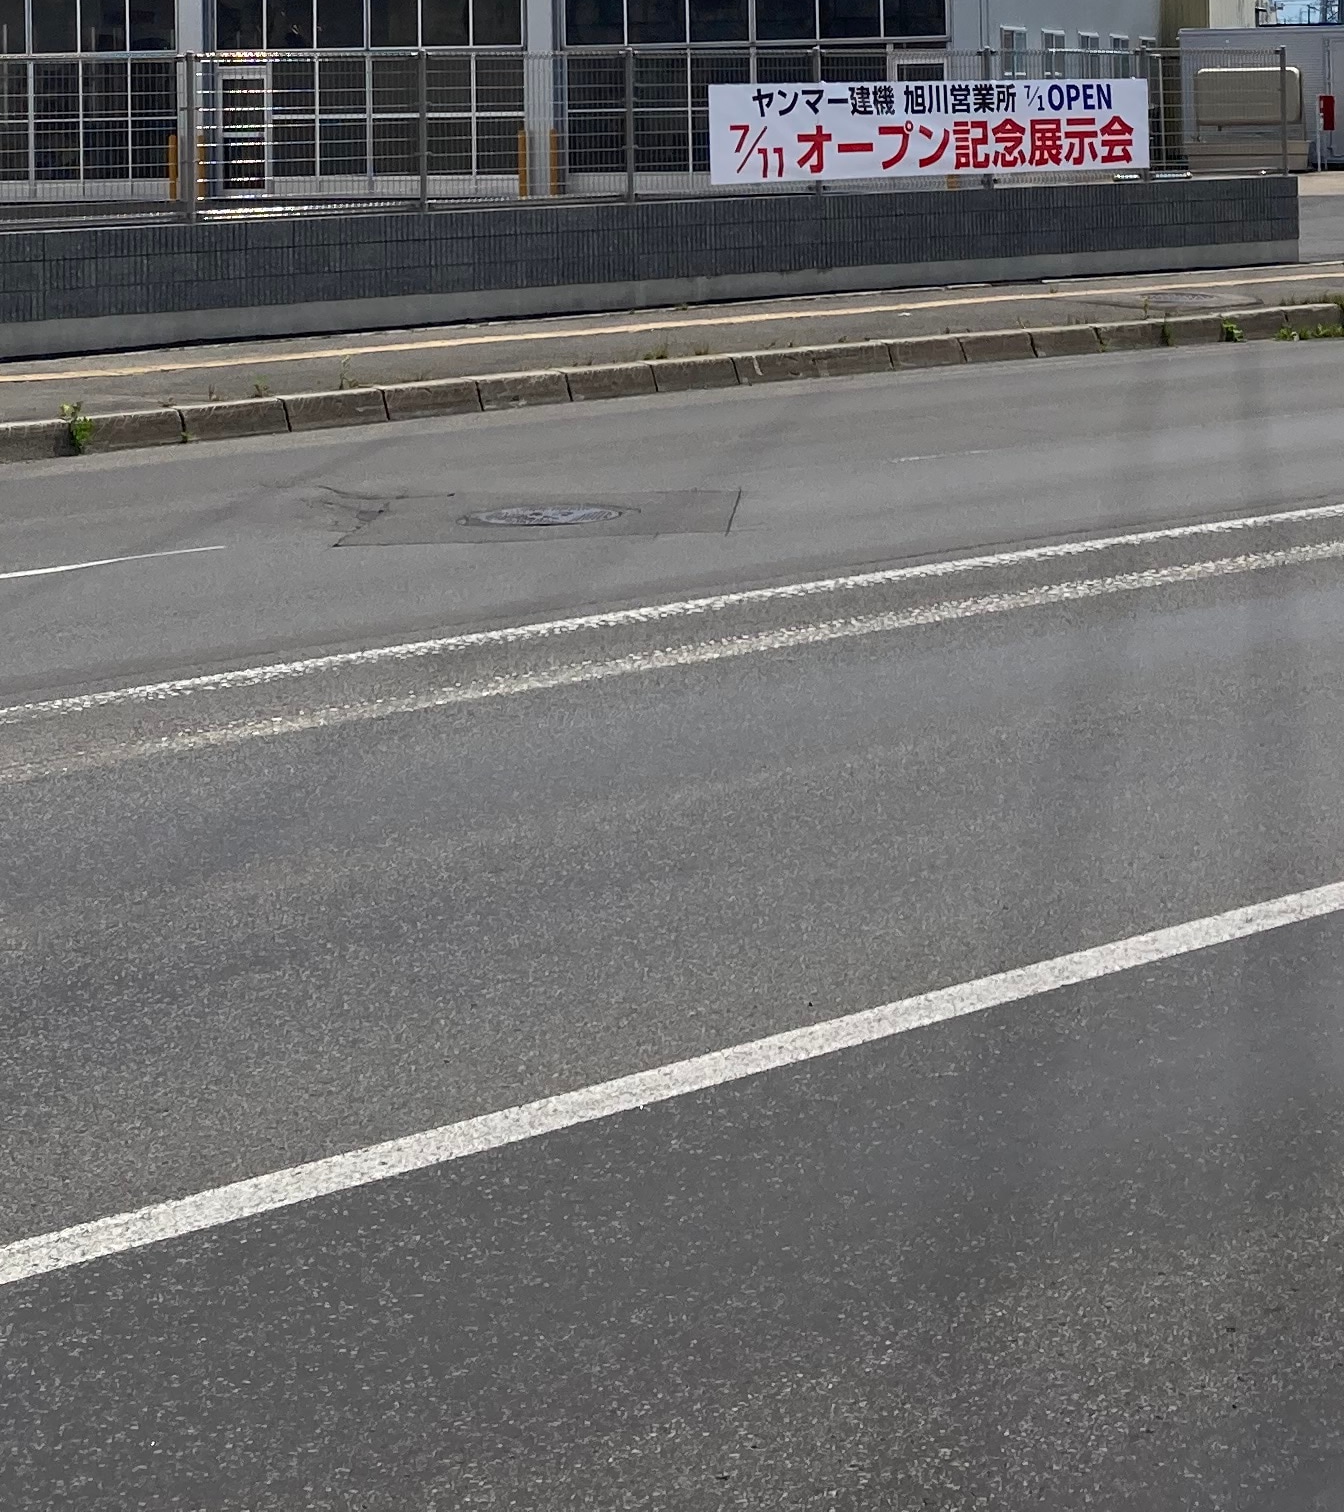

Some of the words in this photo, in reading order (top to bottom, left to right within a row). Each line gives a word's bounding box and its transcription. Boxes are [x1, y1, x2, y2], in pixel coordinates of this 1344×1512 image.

[751, 84, 896, 118] ヤンマー建機
[903, 83, 1017, 115] 旭川営業所
[796, 115, 1134, 174] オープン記念展示会
